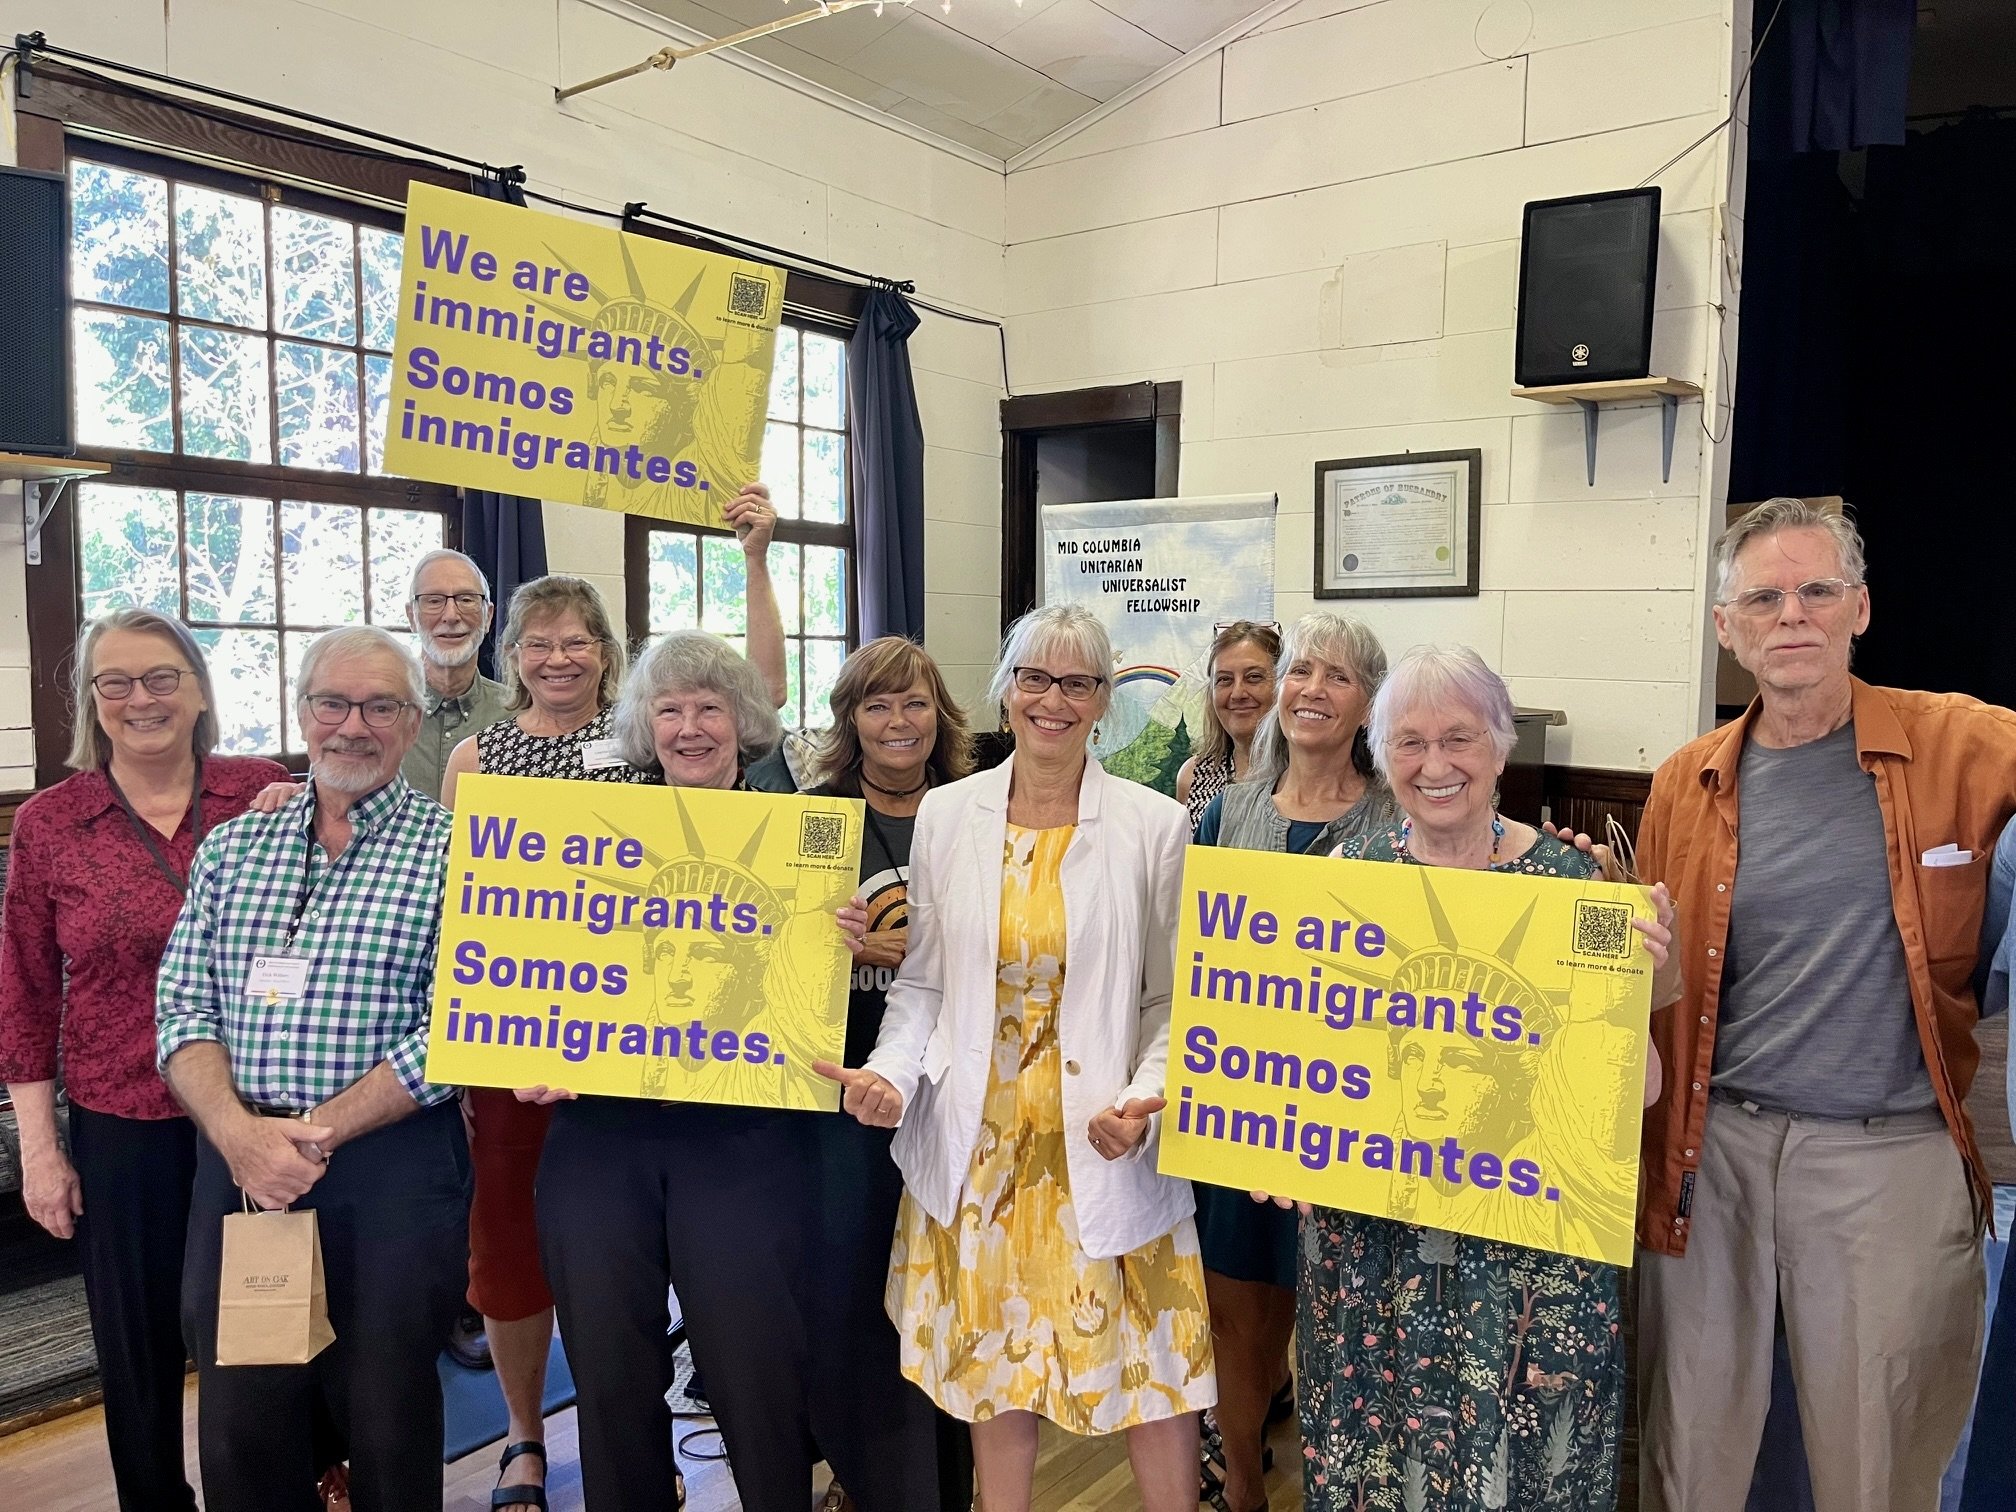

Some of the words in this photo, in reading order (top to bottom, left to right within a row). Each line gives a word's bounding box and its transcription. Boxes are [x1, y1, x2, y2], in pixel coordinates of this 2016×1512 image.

[420, 225, 497, 282] We
[512, 260, 590, 302] are
[413, 281, 703, 379] immigrants.
[407, 347, 574, 415] Somos
[401, 399, 710, 491] inmigrantes.
[1383, 484, 1395, 492] OF
[1058, 541, 1078, 554] MID
[1083, 538, 1141, 554] COLUMBIA
[1080, 559, 1143, 574] UNITARIAN
[1102, 578, 1187, 593] UNIVERSALIST
[1127, 599, 1200, 613] FELLOWSHIP
[469, 814, 547, 862] We
[561, 833, 644, 869] are
[460, 872, 773, 935] immigrants.
[1197, 890, 1278, 945] We
[1294, 916, 1387, 958] are
[453, 940, 629, 995] Somos
[1566, 959, 1586, 968] learn
[1587, 963, 1608, 971] more
[1616, 965, 1644, 975] donate
[1582, 950, 1602, 958] SCAN
[1190, 952, 1542, 1045] immigrants.
[446, 998, 786, 1066] inmigrantes.
[1183, 1026, 1372, 1100] Somos
[1177, 1085, 1561, 1202] inmigrantes.
